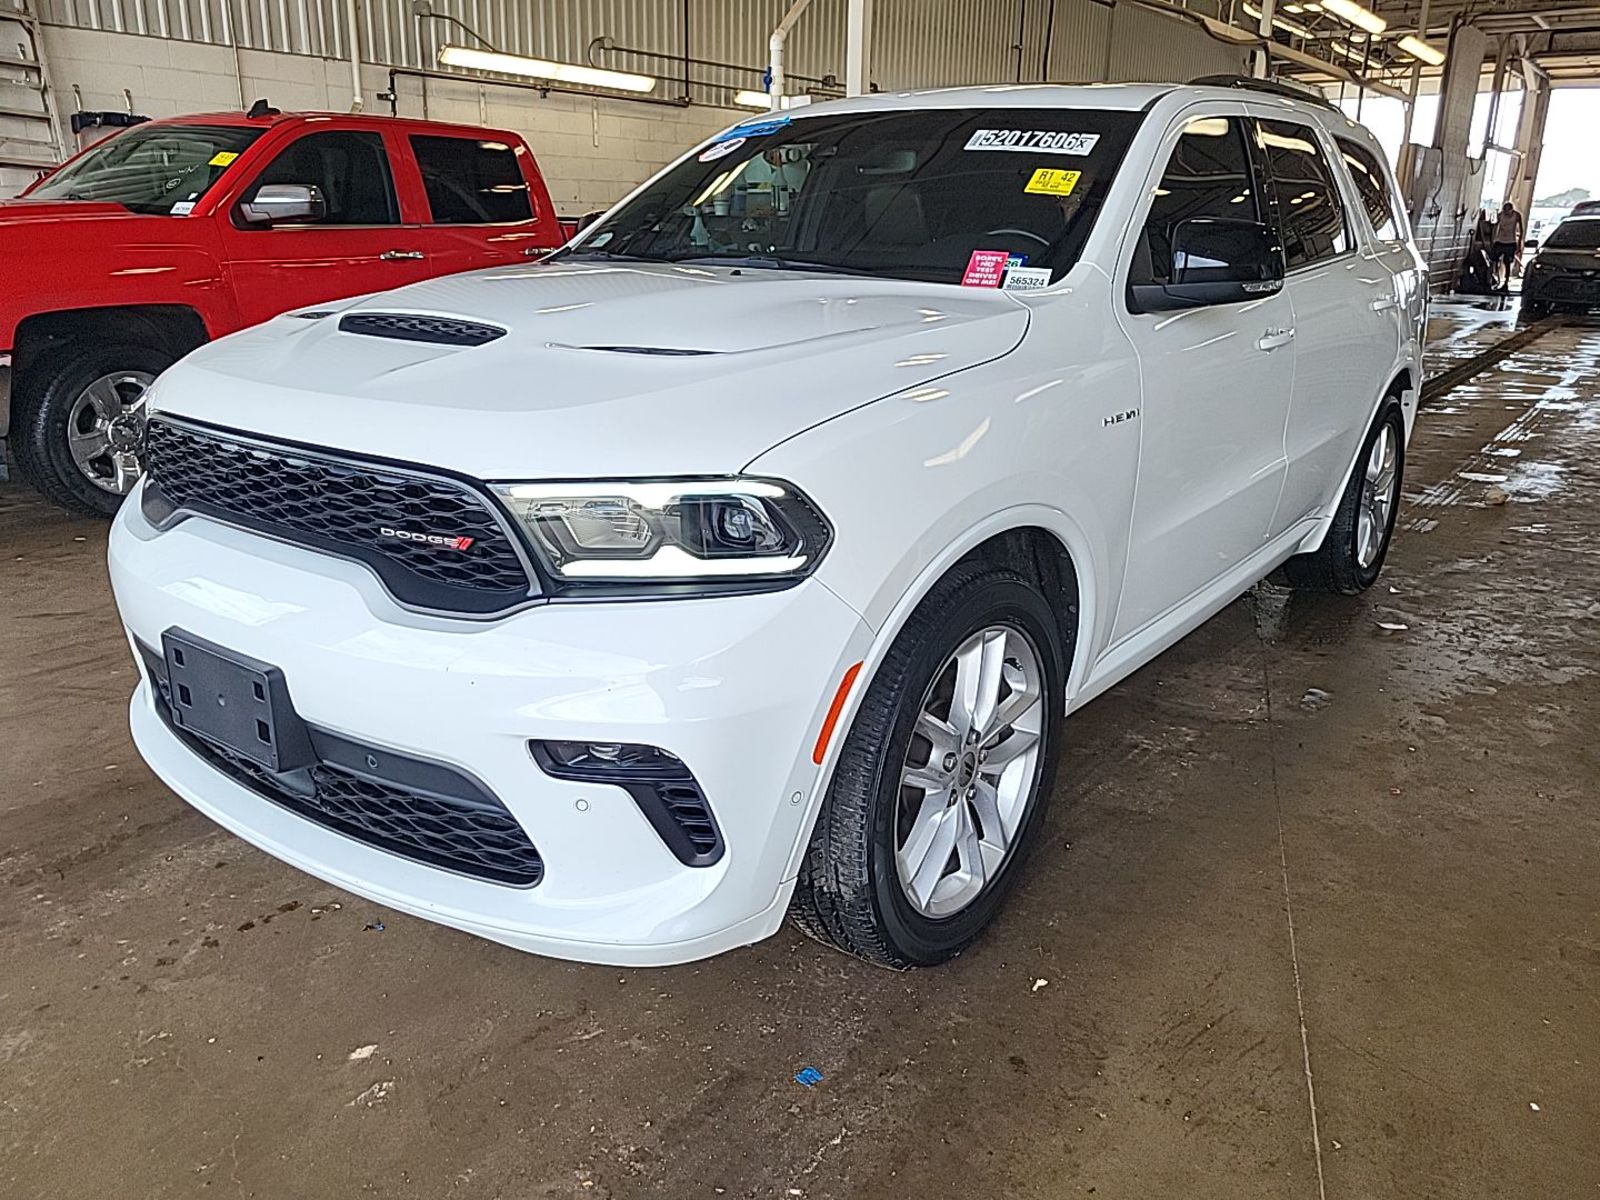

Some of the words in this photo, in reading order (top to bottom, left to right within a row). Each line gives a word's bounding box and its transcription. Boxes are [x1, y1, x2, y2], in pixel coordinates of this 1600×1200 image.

[981, 130, 1080, 150] 52017606
[1061, 172, 1076, 182] 42
[1009, 276, 1045, 286] 565324
[380, 527, 460, 549] DODGE
